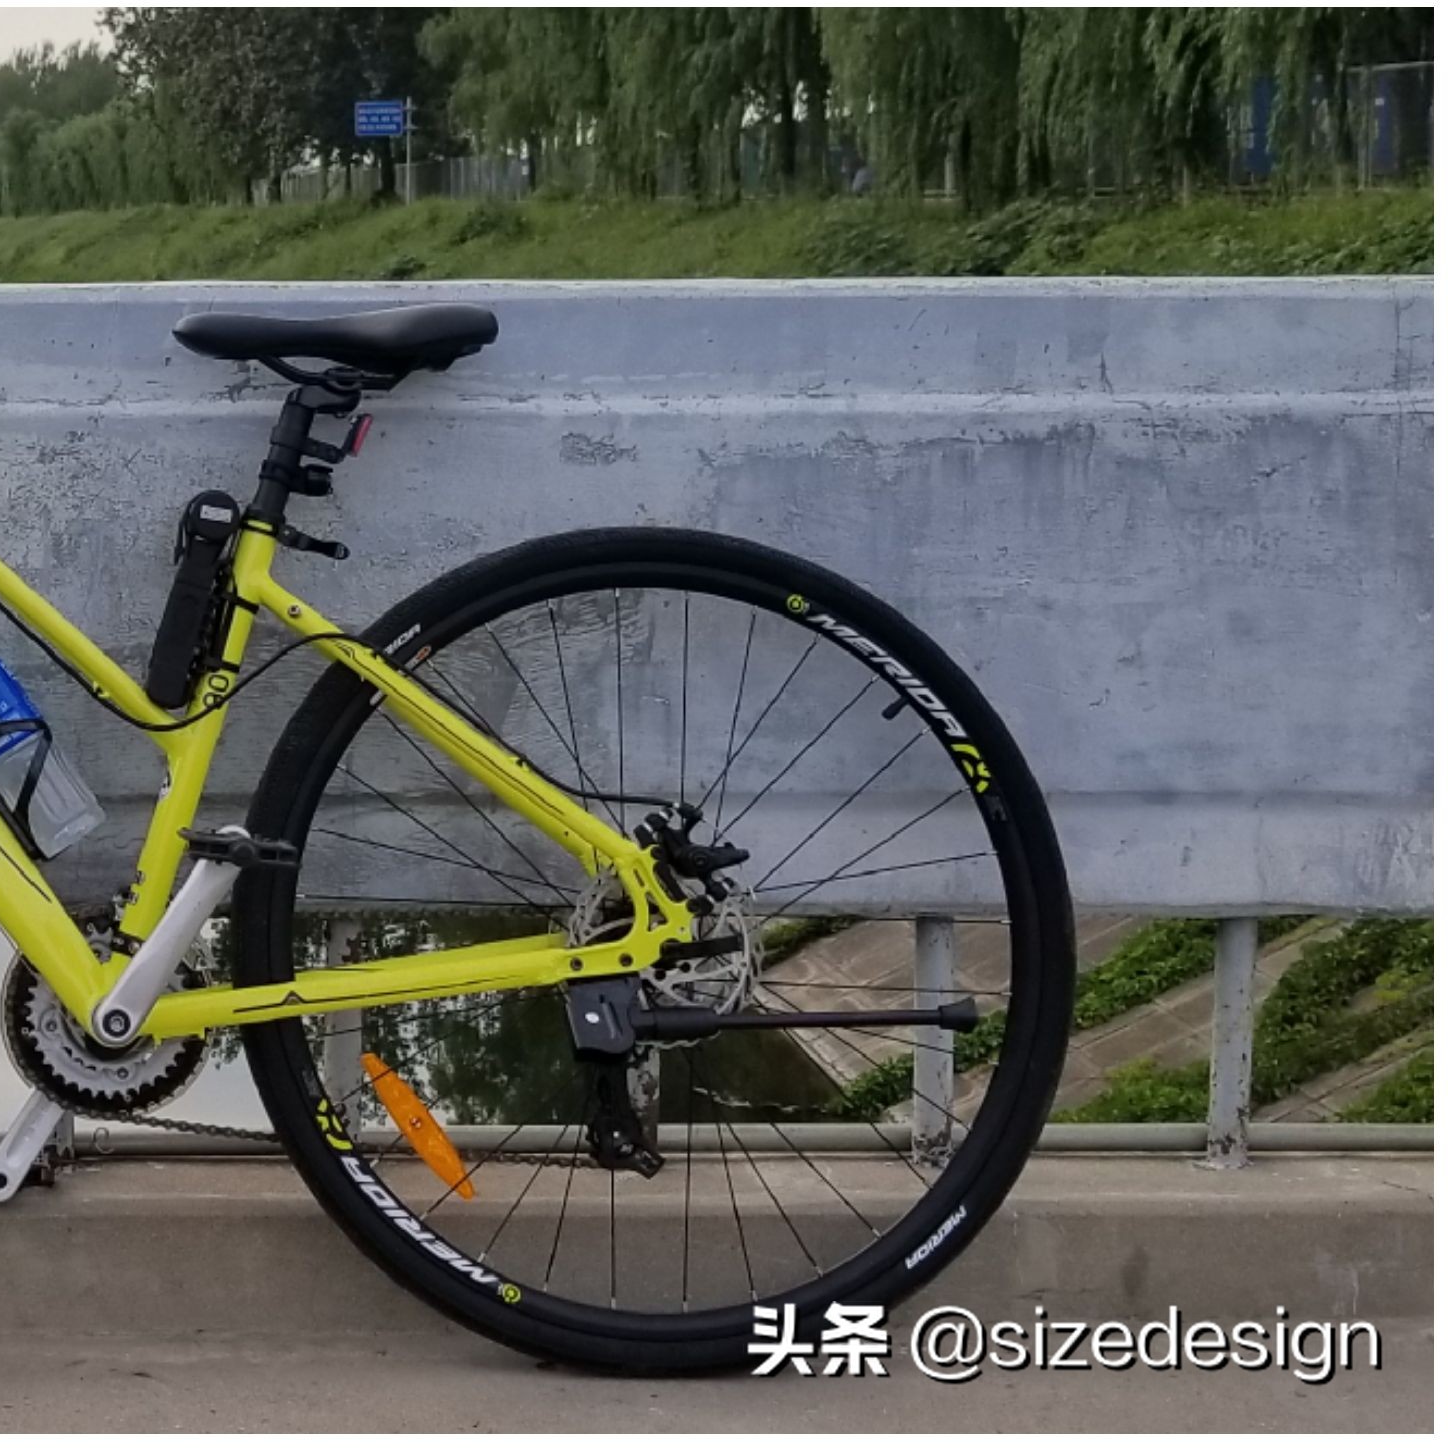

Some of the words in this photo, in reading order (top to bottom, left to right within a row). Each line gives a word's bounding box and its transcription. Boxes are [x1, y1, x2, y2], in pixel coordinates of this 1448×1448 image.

[806, 613, 968, 739] MERIDA
[340, 1155, 500, 1284] MERIDA
[905, 1204, 967, 1269] MERIDA
